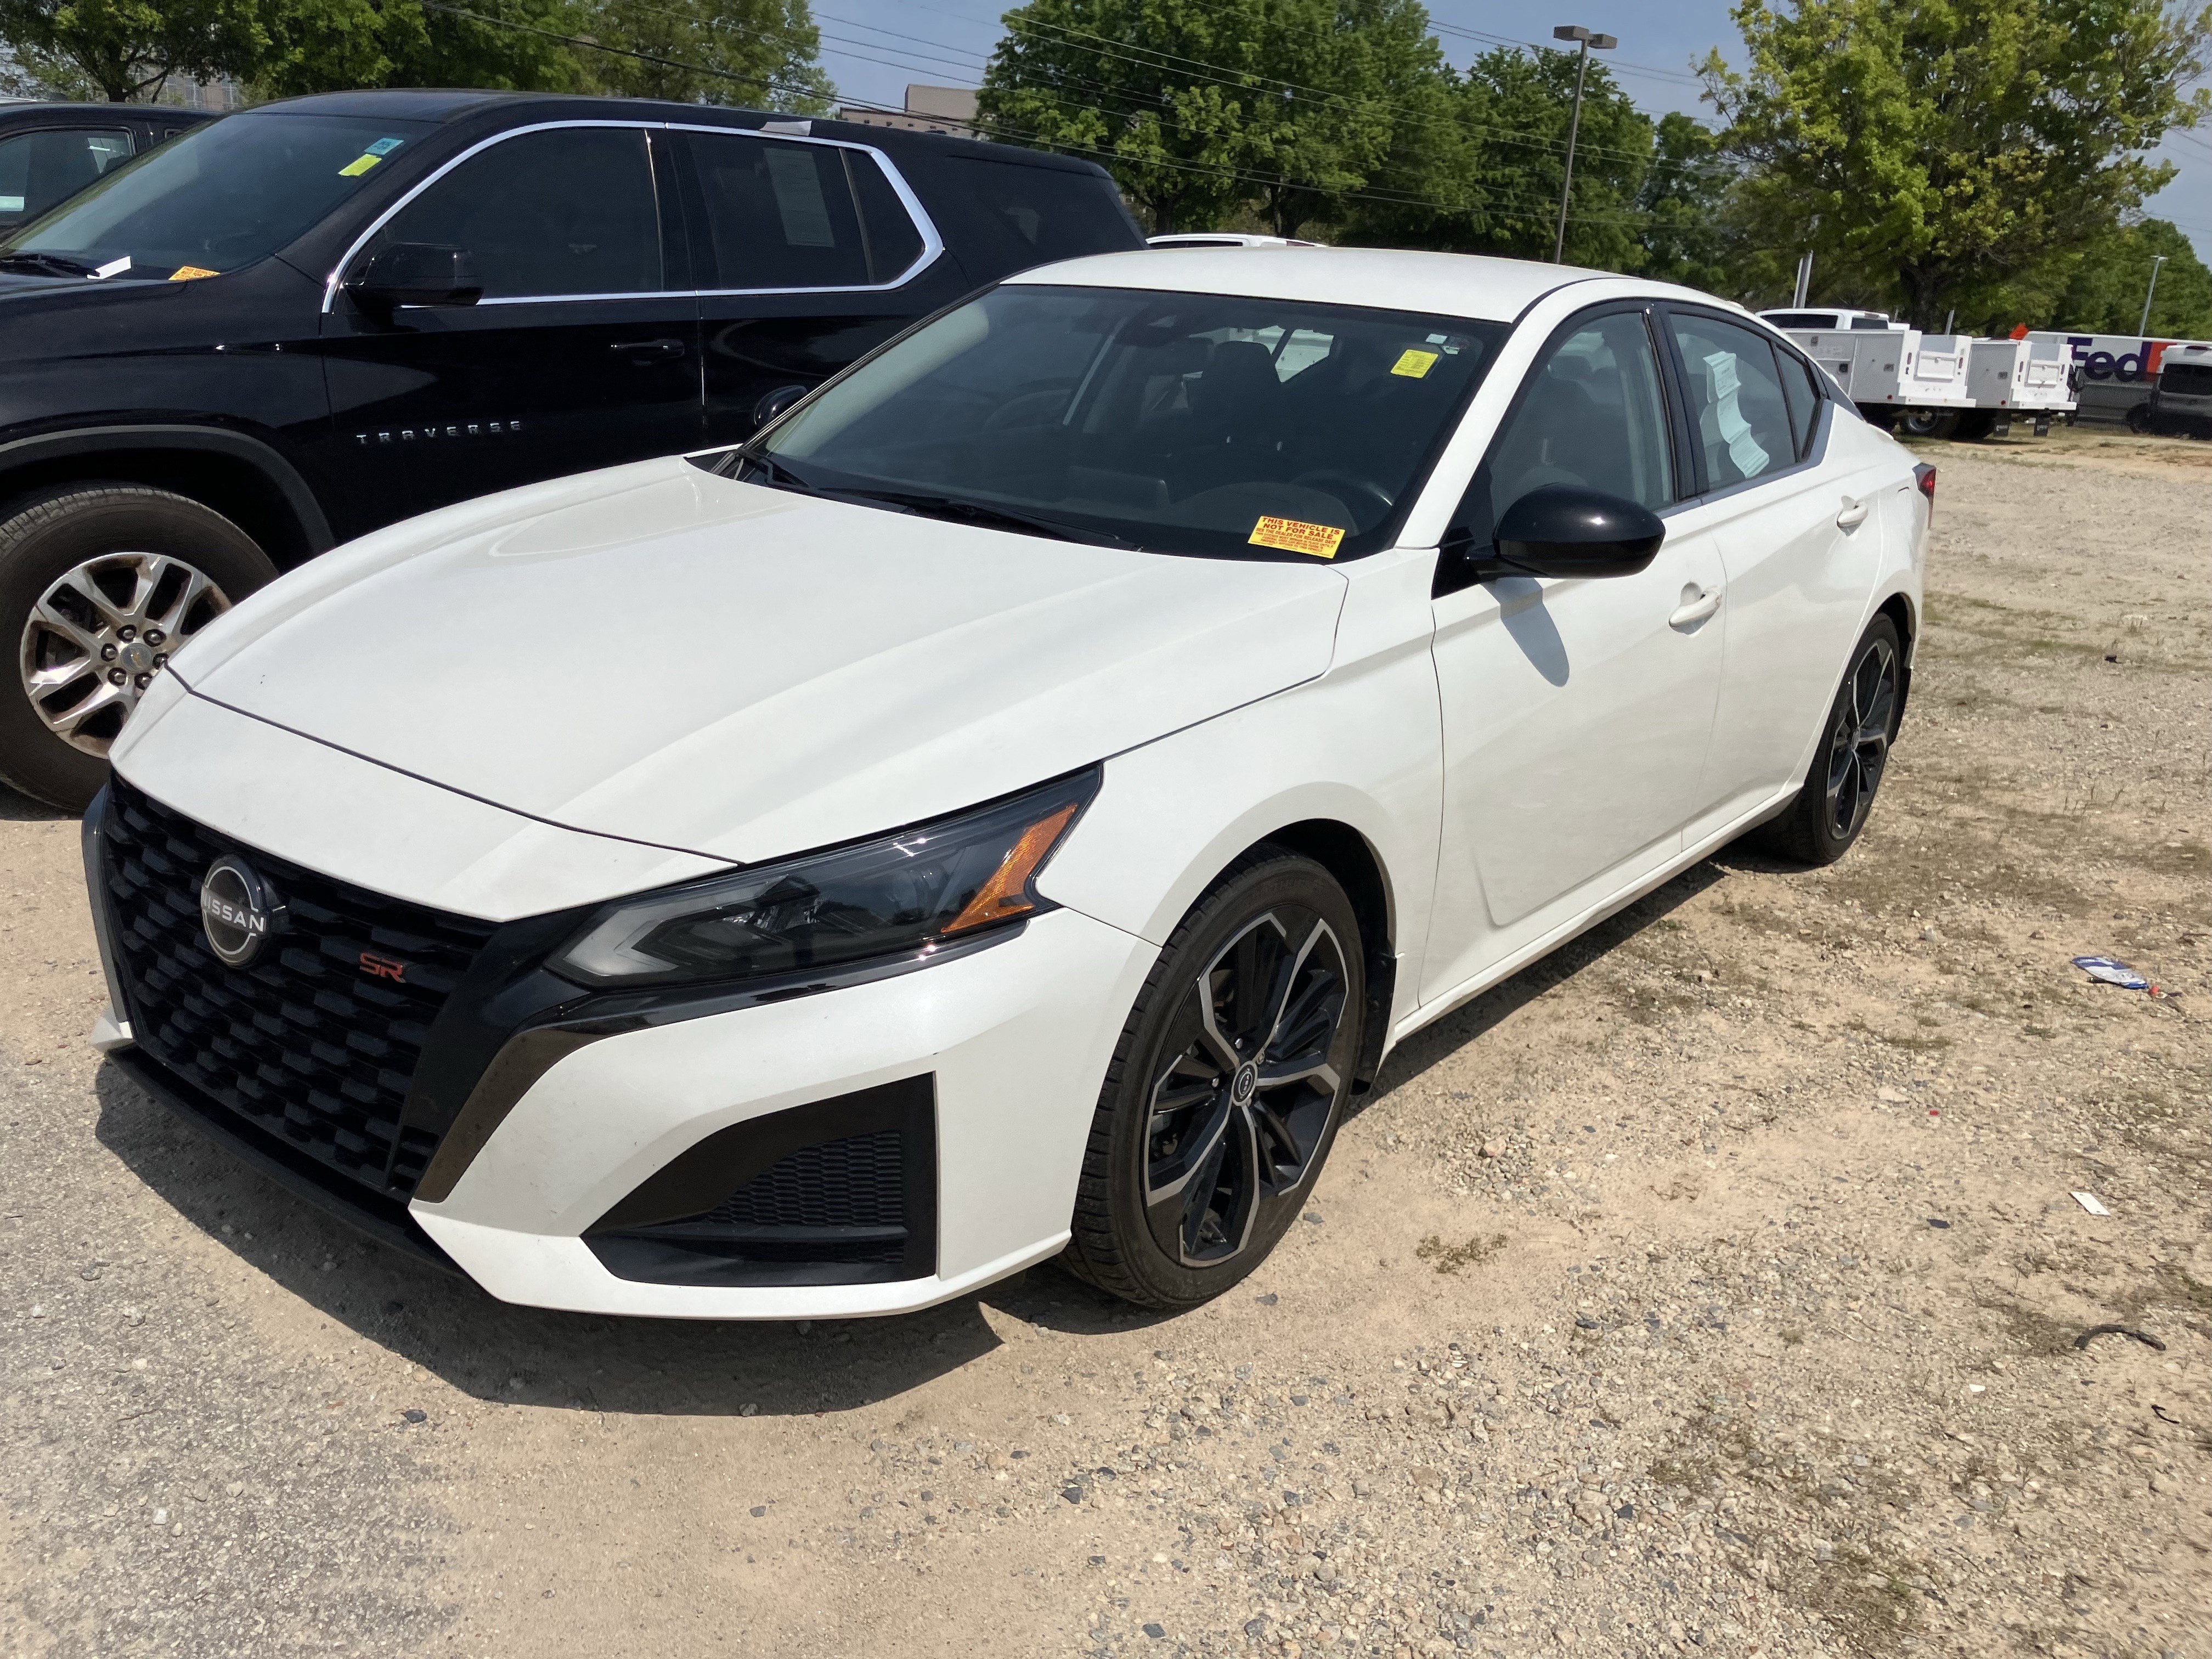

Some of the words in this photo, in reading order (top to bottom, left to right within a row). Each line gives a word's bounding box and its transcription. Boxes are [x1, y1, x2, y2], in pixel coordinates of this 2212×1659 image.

[356, 421, 520, 444] TRAVERSE
[1285, 527, 1306, 535] FOR
[1308, 531, 1334, 540] SALE
[1287, 521, 1328, 533] VEHICLE
[201, 893, 266, 932] NISSAN
[359, 952, 407, 984] SR
